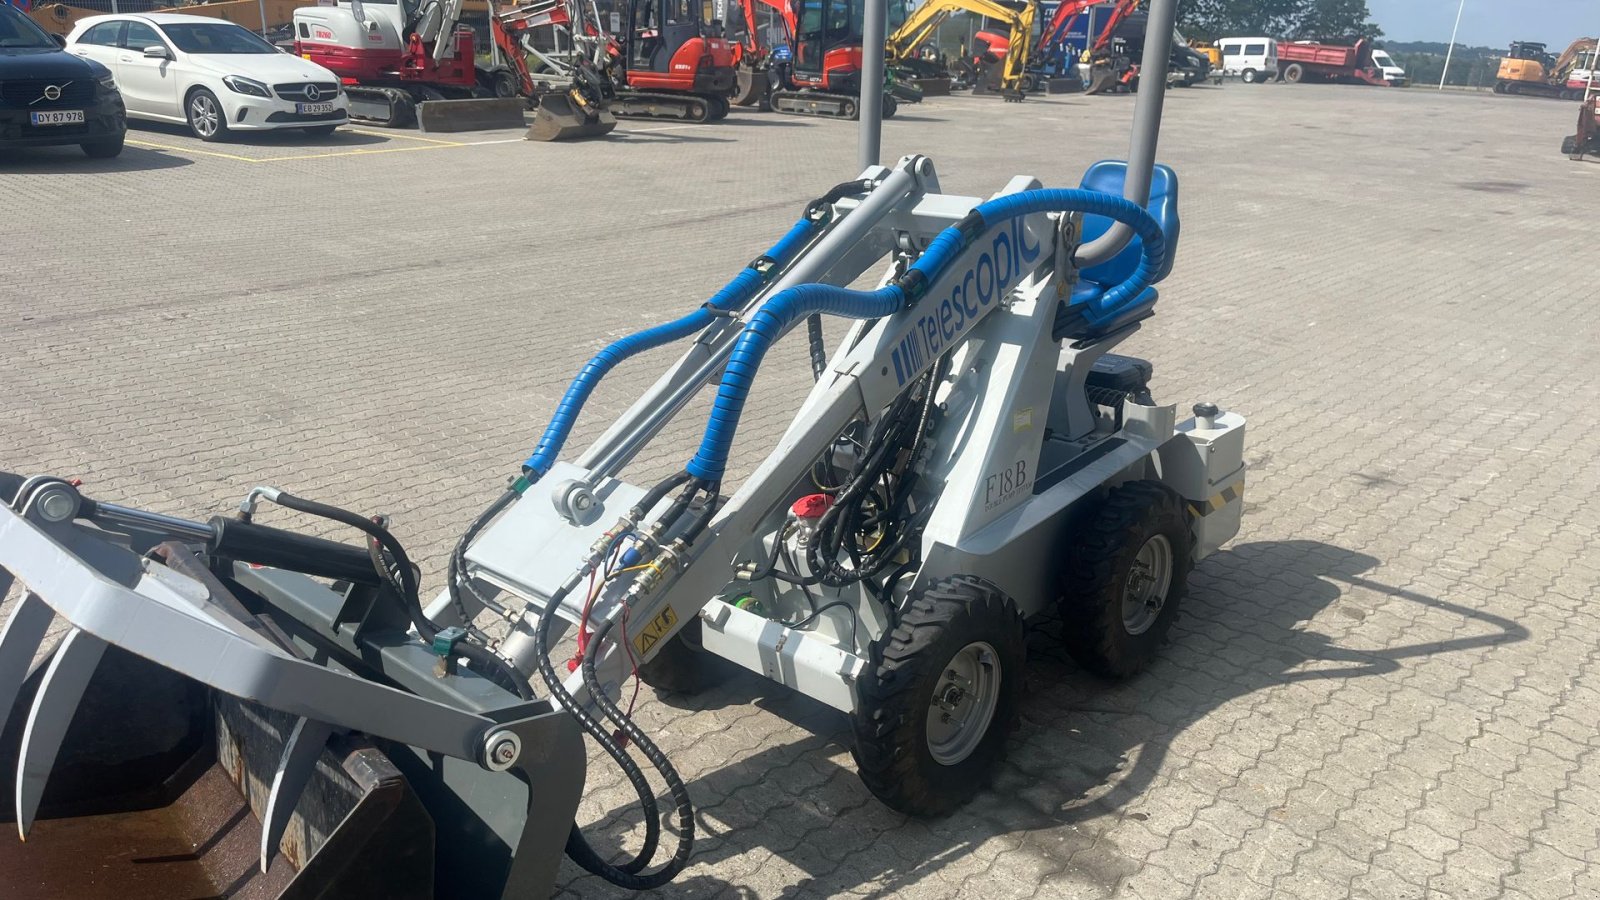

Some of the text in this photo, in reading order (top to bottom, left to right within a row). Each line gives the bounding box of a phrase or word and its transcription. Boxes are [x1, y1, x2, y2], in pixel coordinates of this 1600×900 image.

[303, 104, 332, 112] EB 29 352
[38, 112, 84, 123] DY 87 978
[918, 214, 1041, 360] Telescopic
